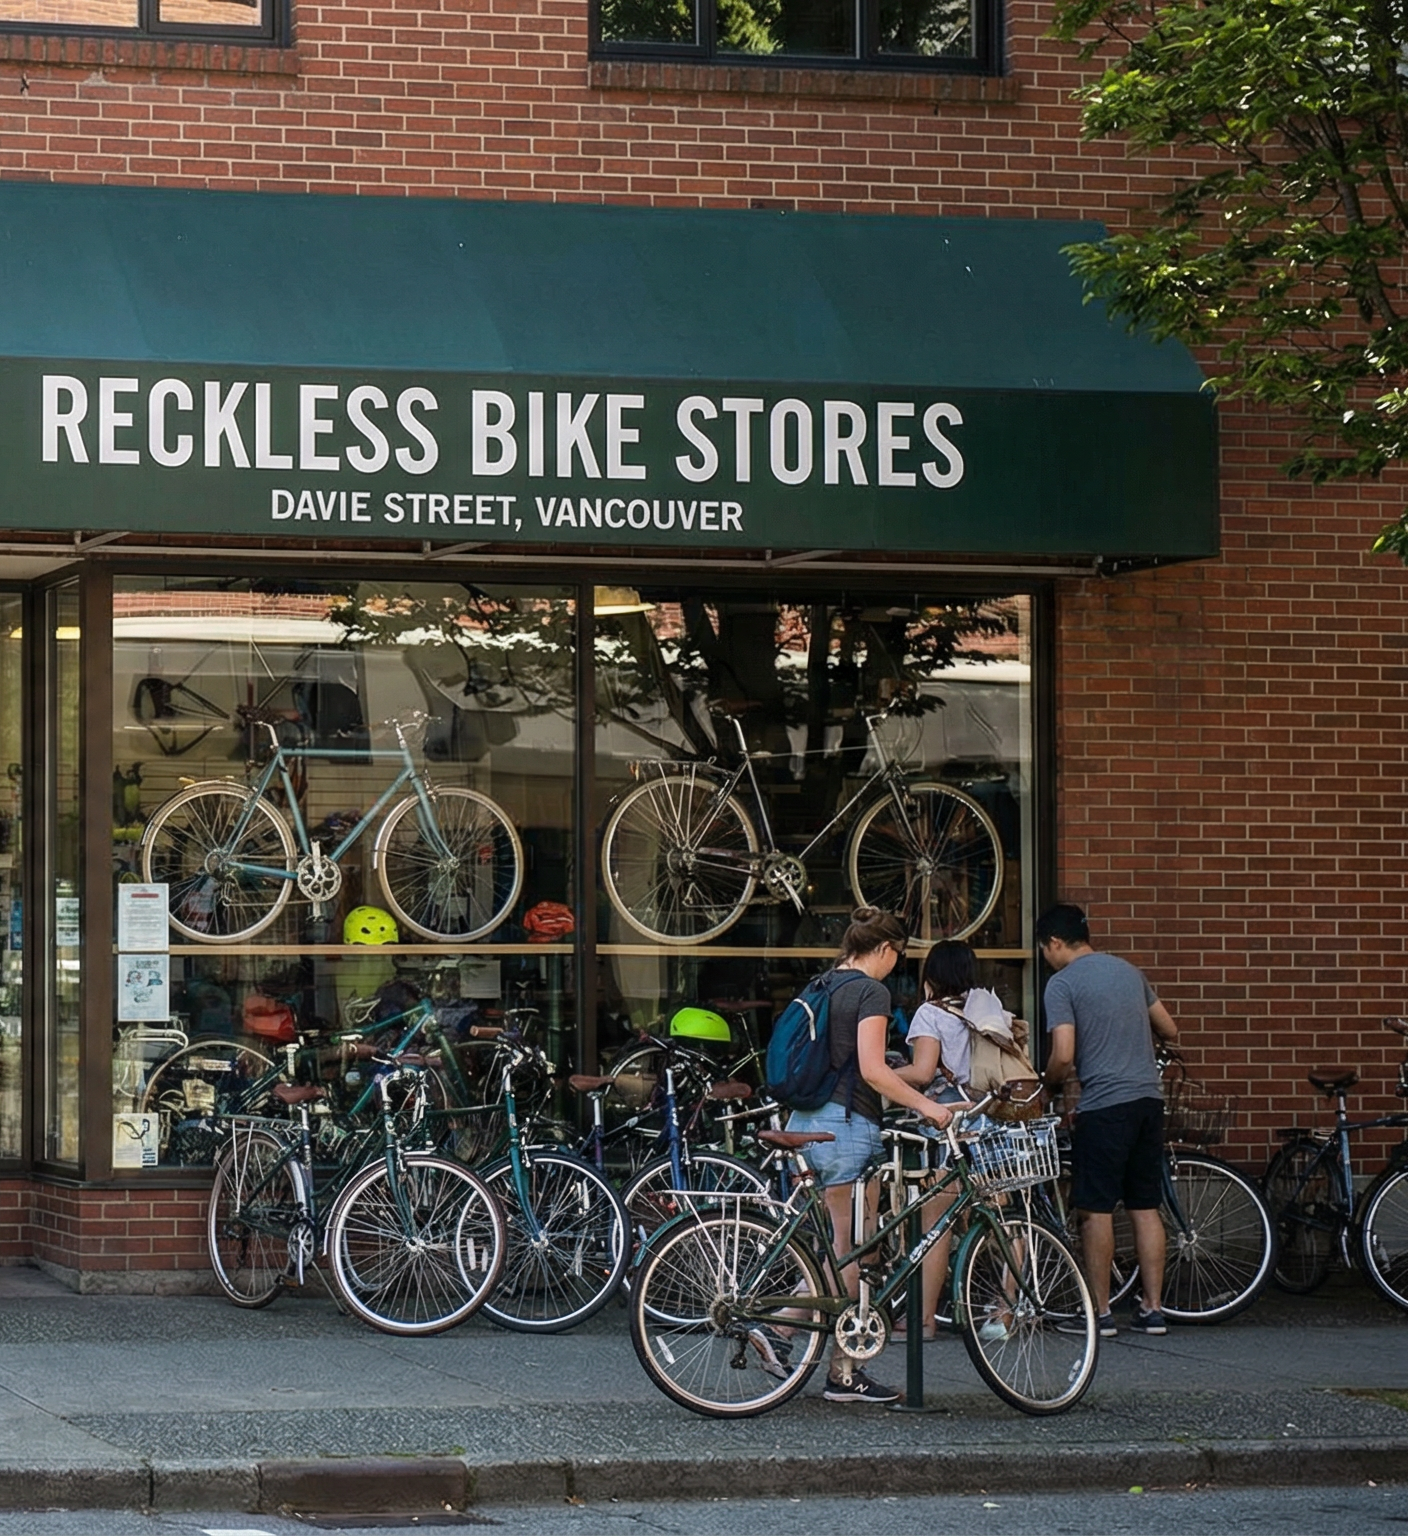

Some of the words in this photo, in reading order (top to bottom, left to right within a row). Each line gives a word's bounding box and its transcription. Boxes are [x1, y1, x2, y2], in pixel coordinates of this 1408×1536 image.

[41, 374, 439, 476] RECKLESS
[471, 389, 647, 480] BIKE
[675, 395, 965, 489] STORES
[270, 489, 372, 523] DAVIE
[383, 491, 523, 532] STREET,
[535, 496, 744, 532] VANCOUVER
